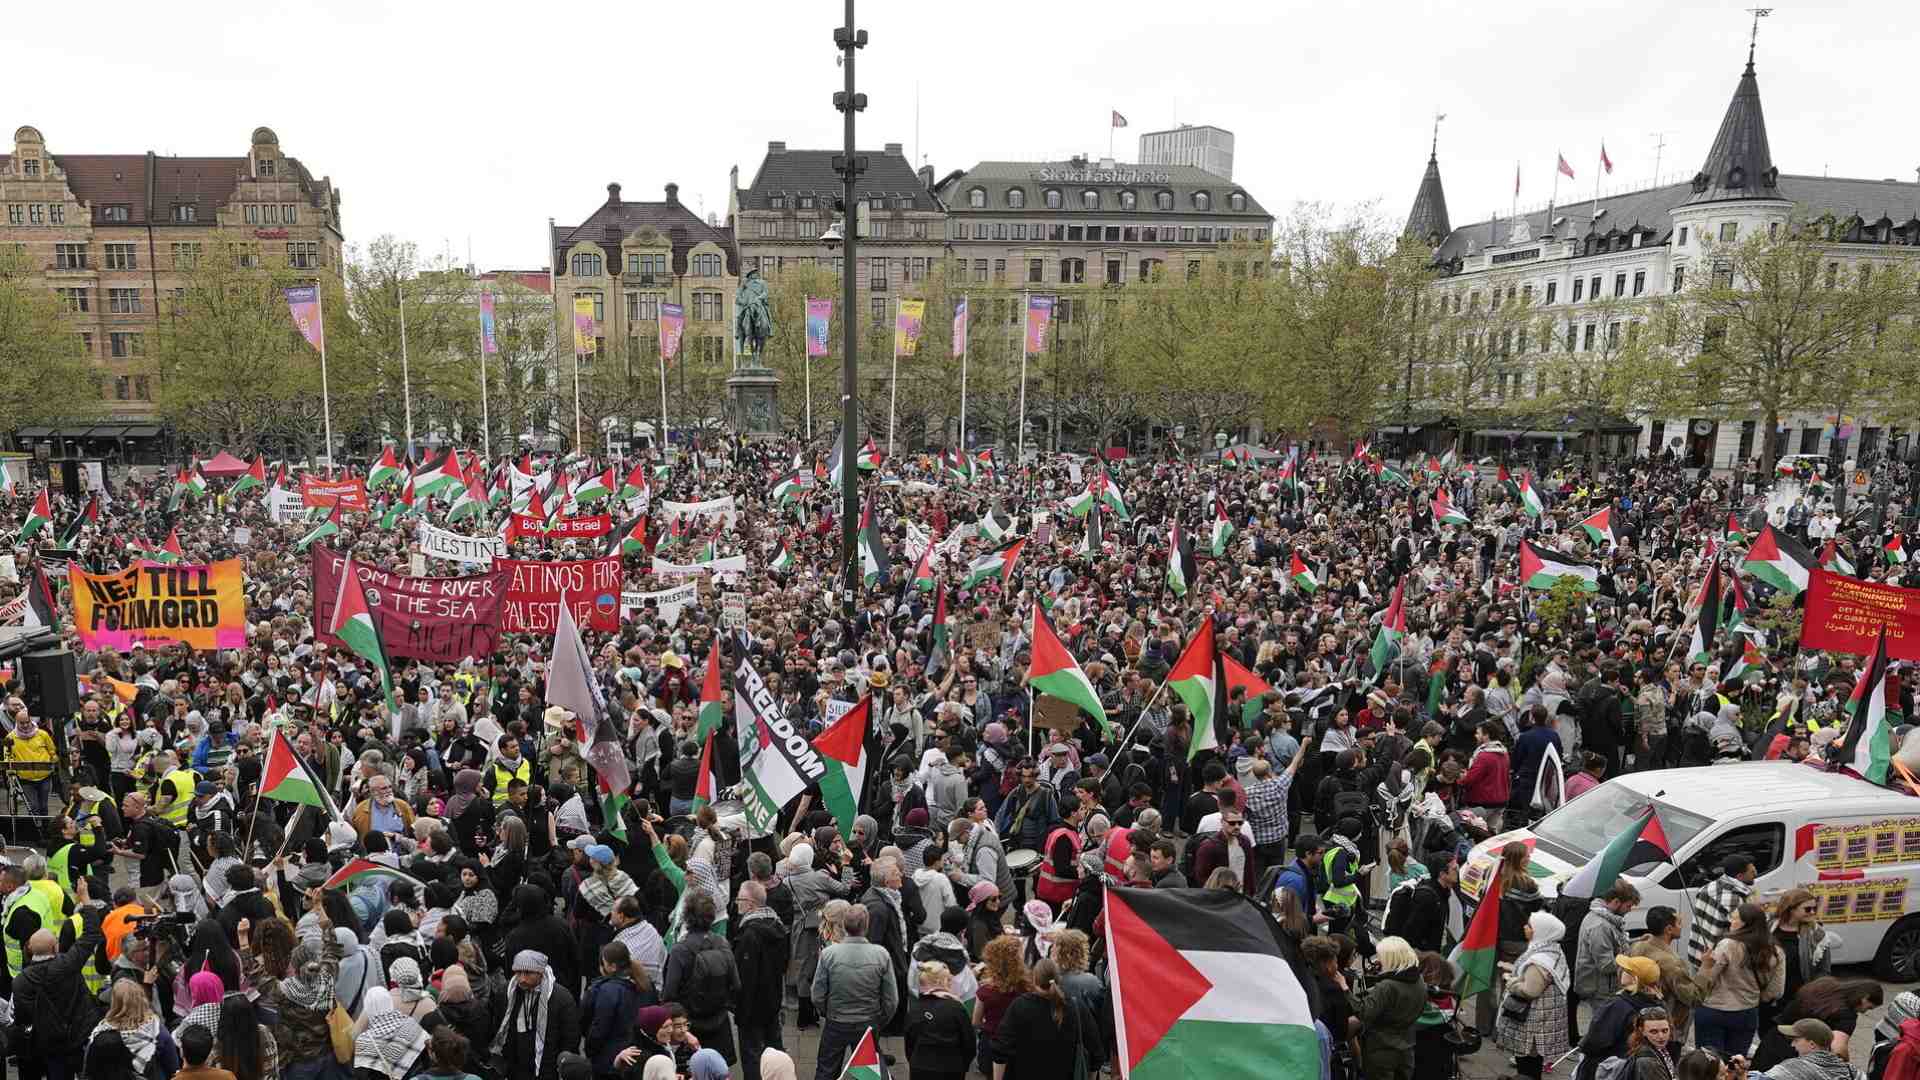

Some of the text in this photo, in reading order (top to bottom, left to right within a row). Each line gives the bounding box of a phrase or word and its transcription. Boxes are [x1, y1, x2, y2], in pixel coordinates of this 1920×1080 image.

[572, 520, 600, 531] Israel
[85, 566, 217, 603] NEJ TILL
[332, 558, 388, 586] FOM
[441, 580, 496, 598] RIVER
[592, 560, 620, 592] FOR
[91, 599, 219, 631] FOLKMORD
[392, 593, 431, 613] THE
[436, 598, 477, 621] SEA
[622, 595, 643, 606] DENTS
[735, 657, 825, 779] FREEDOM
